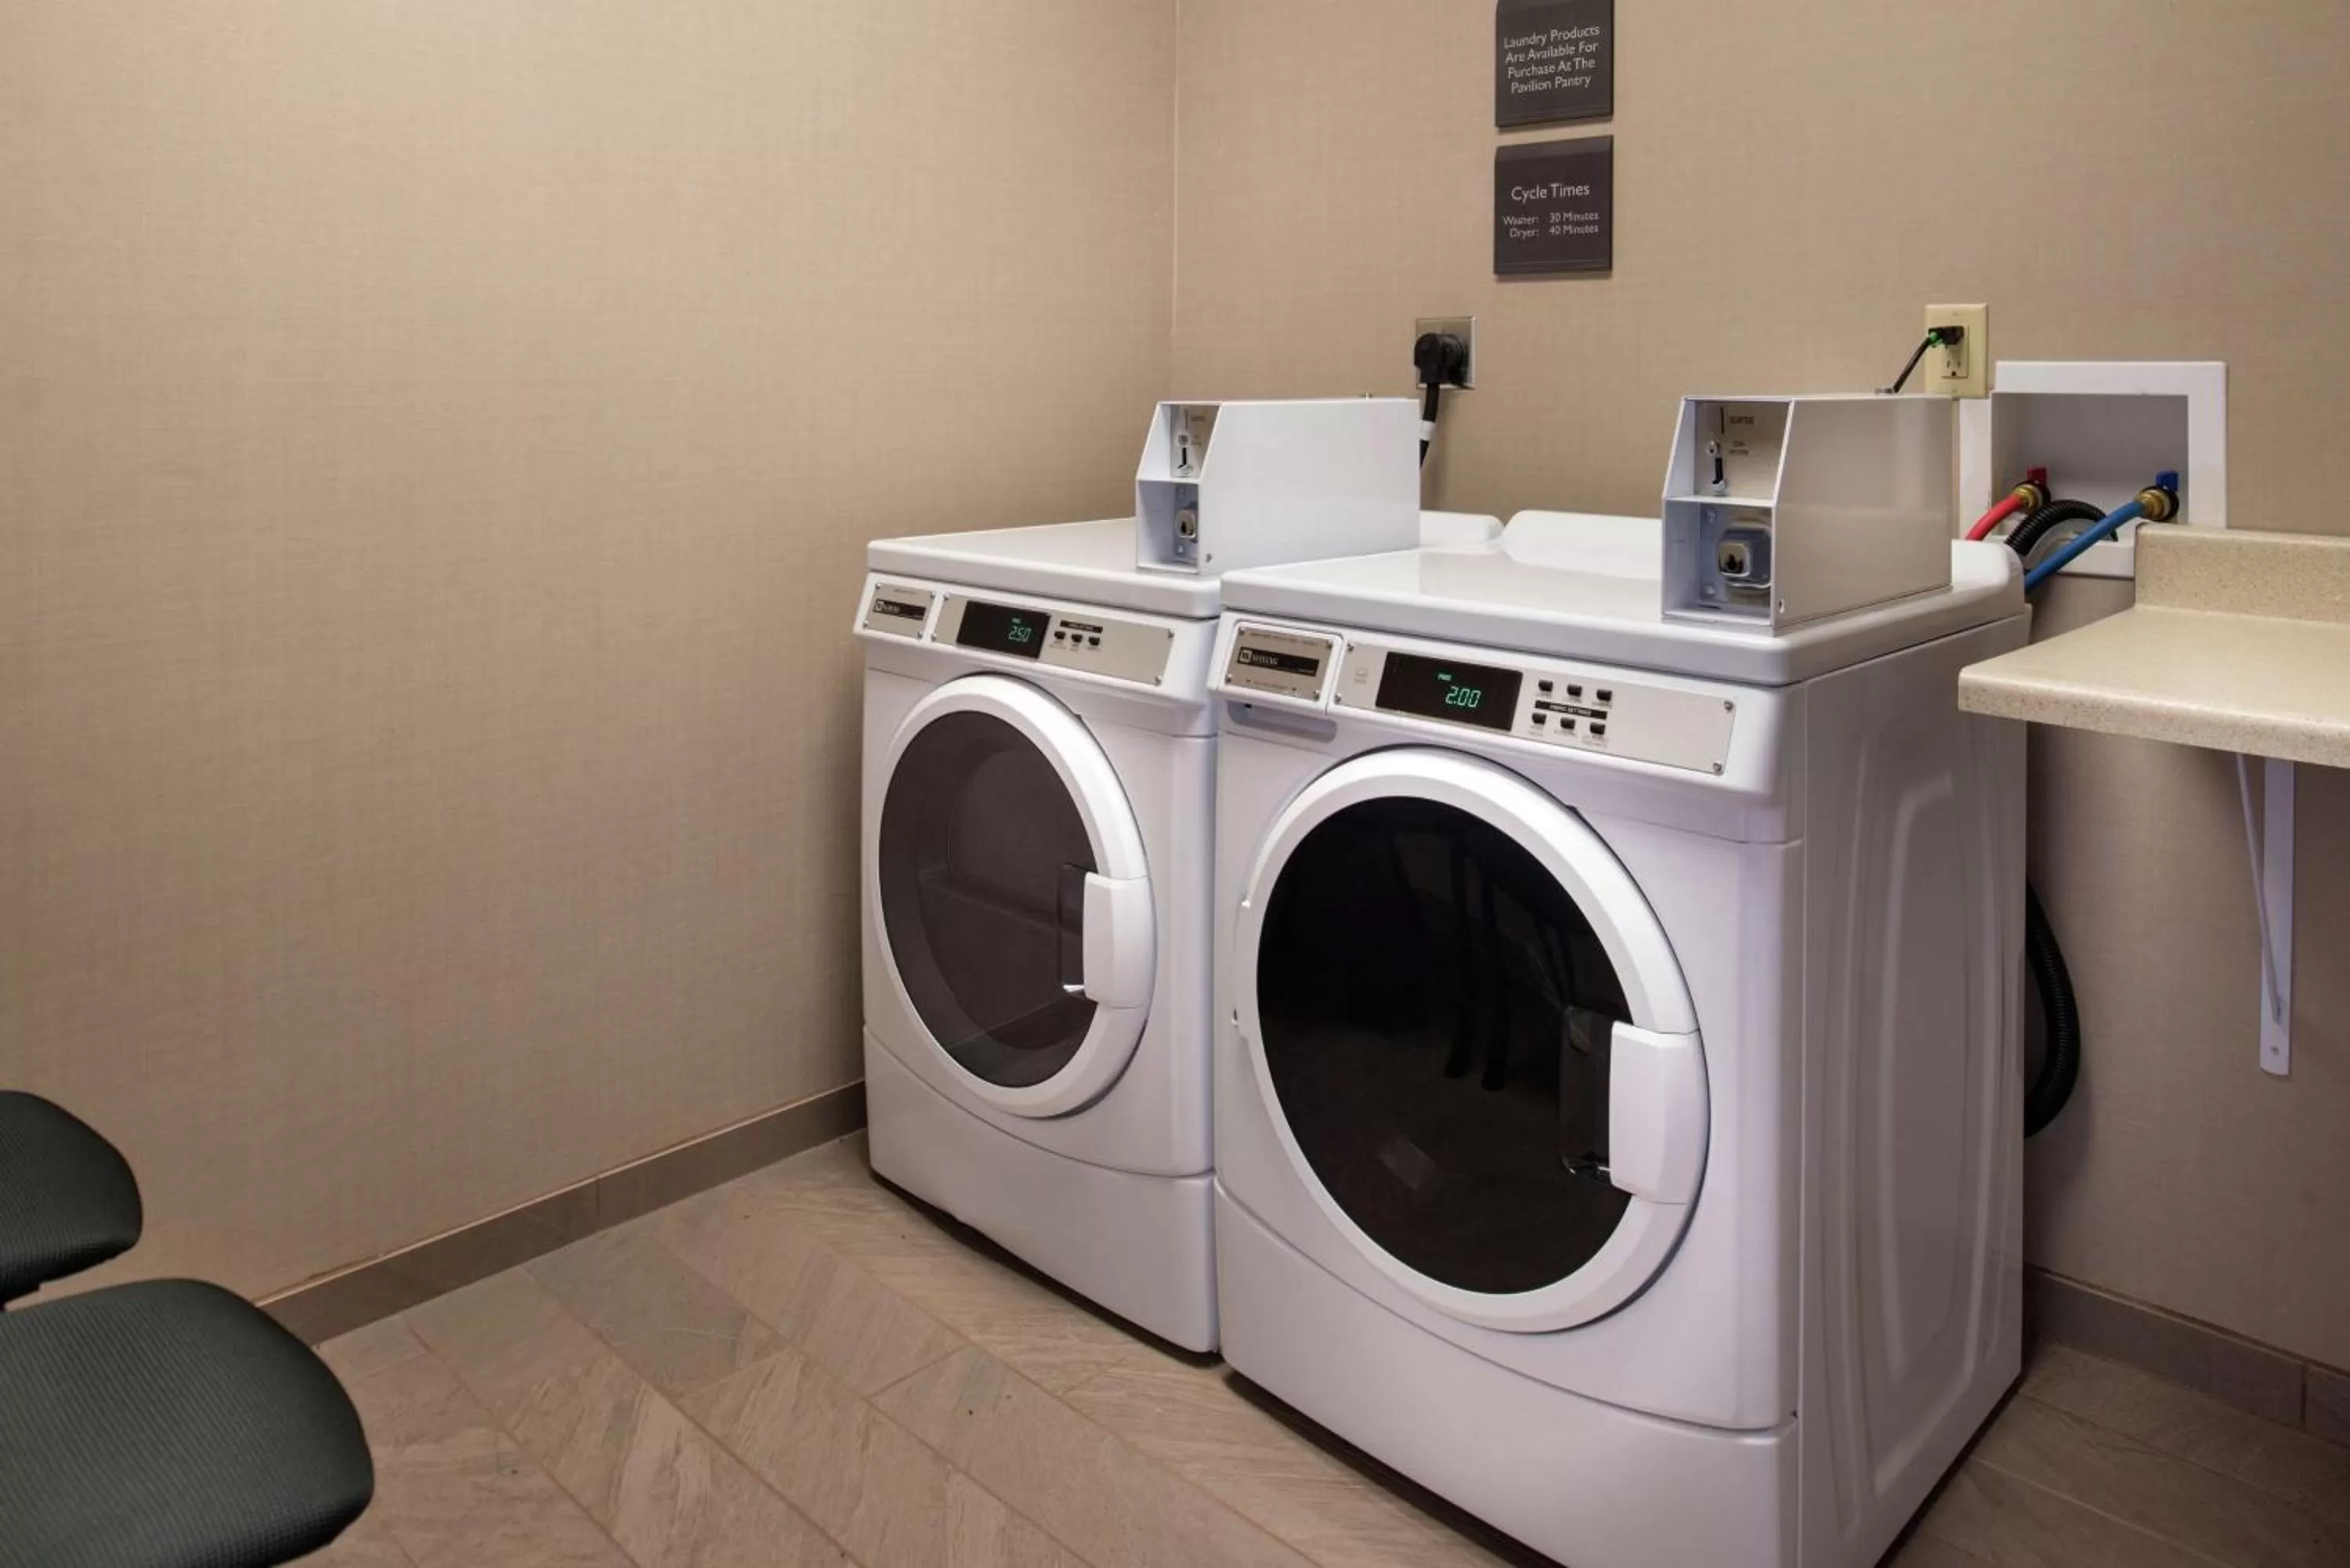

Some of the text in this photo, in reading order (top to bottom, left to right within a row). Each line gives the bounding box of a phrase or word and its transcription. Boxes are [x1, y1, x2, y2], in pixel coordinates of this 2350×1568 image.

[1503, 27, 1600, 49] Laundry Products
[1505, 40, 1599, 63] Are Available For
[1508, 57, 1596, 79] Purchase At The
[1511, 75, 1591, 94] Pavilion Pantry
[1511, 182, 1590, 204] Cycle Times
[1549, 212, 1561, 223] 30
[1563, 211, 1600, 222] Minutes
[1509, 224, 1599, 239] Dryer: 40 Minutes
[1445, 685, 1481, 707] 2.00
